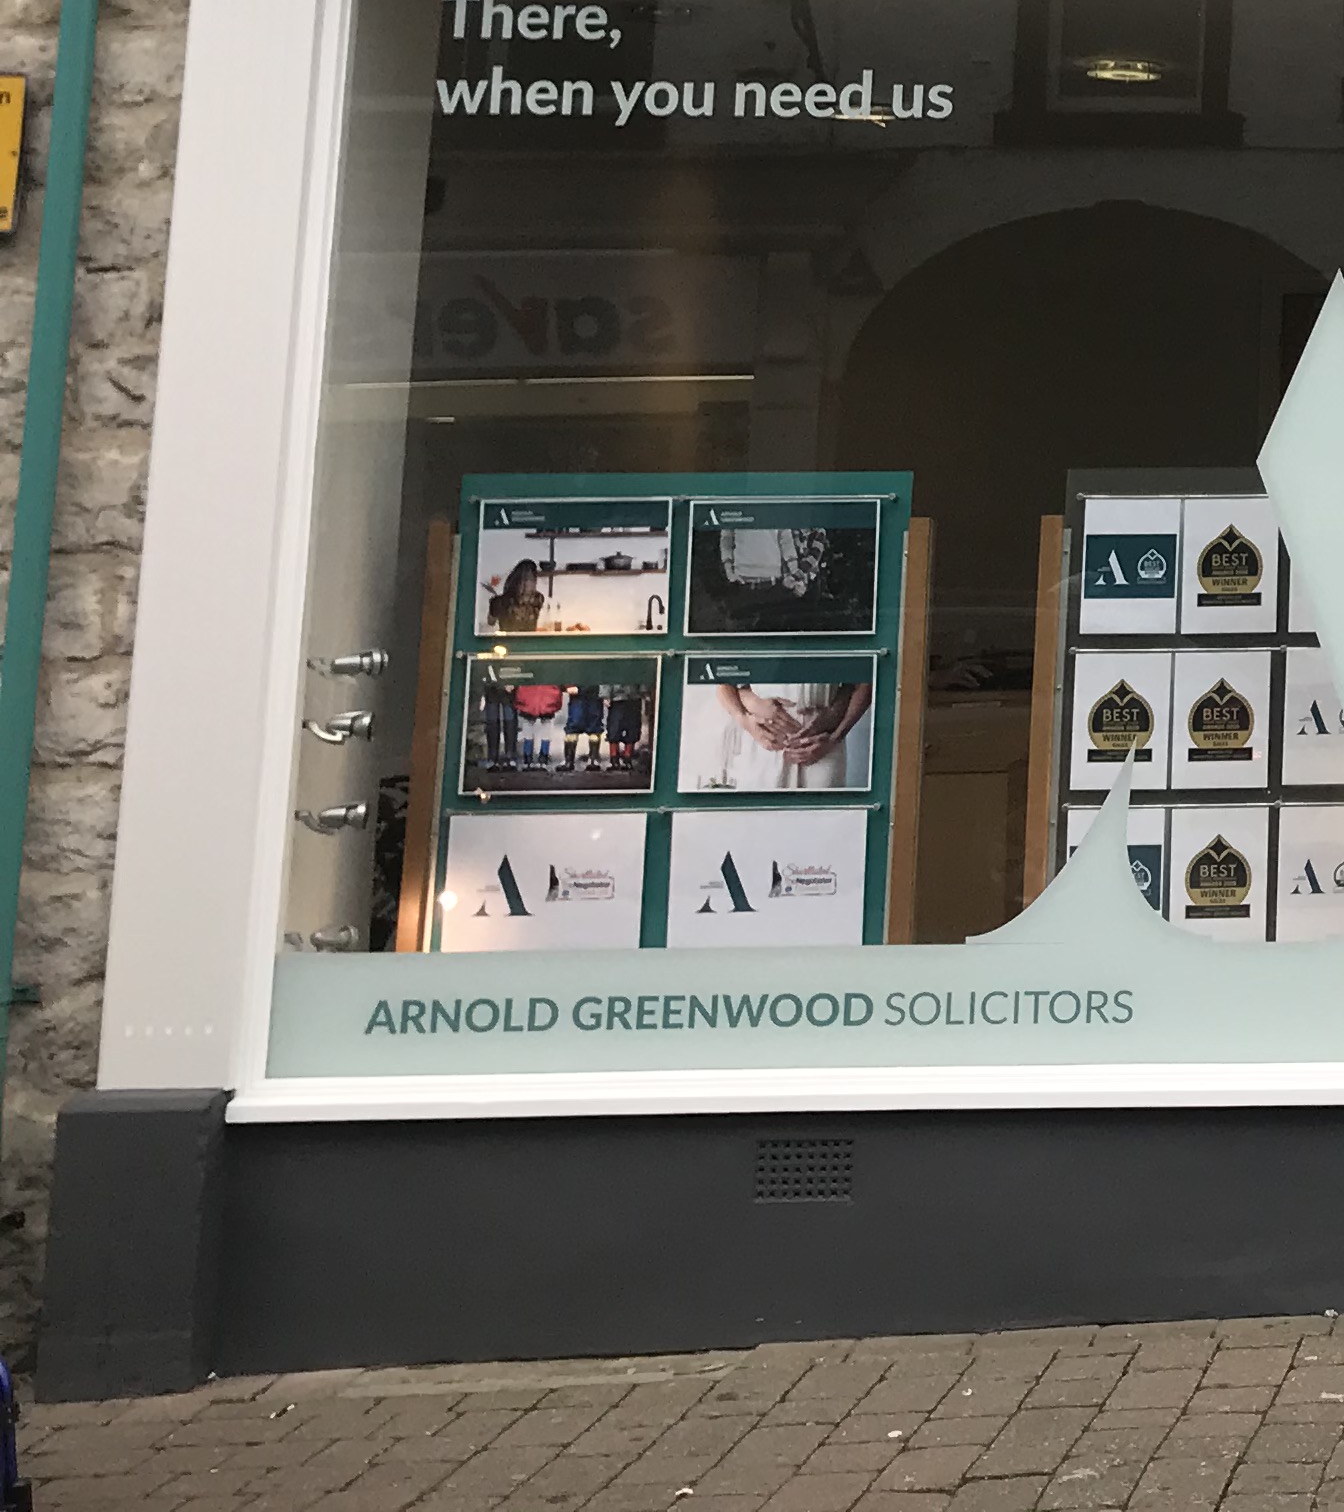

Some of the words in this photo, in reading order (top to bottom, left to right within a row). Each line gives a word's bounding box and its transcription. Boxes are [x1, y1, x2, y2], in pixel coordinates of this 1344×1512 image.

[437, 65, 594, 117] when
[610, 80, 714, 127] you
[734, 68, 874, 119] need
[891, 82, 954, 120] us
[1211, 553, 1248, 566] BEST
[1212, 577, 1248, 587] WINNER
[1102, 708, 1140, 722] BEST
[1202, 707, 1240, 721] BEST
[1203, 731, 1239, 741] WINNER
[1199, 863, 1238, 878] BEST
[1200, 889, 1237, 898] WINNER
[364, 998, 560, 1036] ARNOLD
[572, 991, 874, 1031] GREENWOOD
[883, 990, 1135, 1026] SOLICITORS
